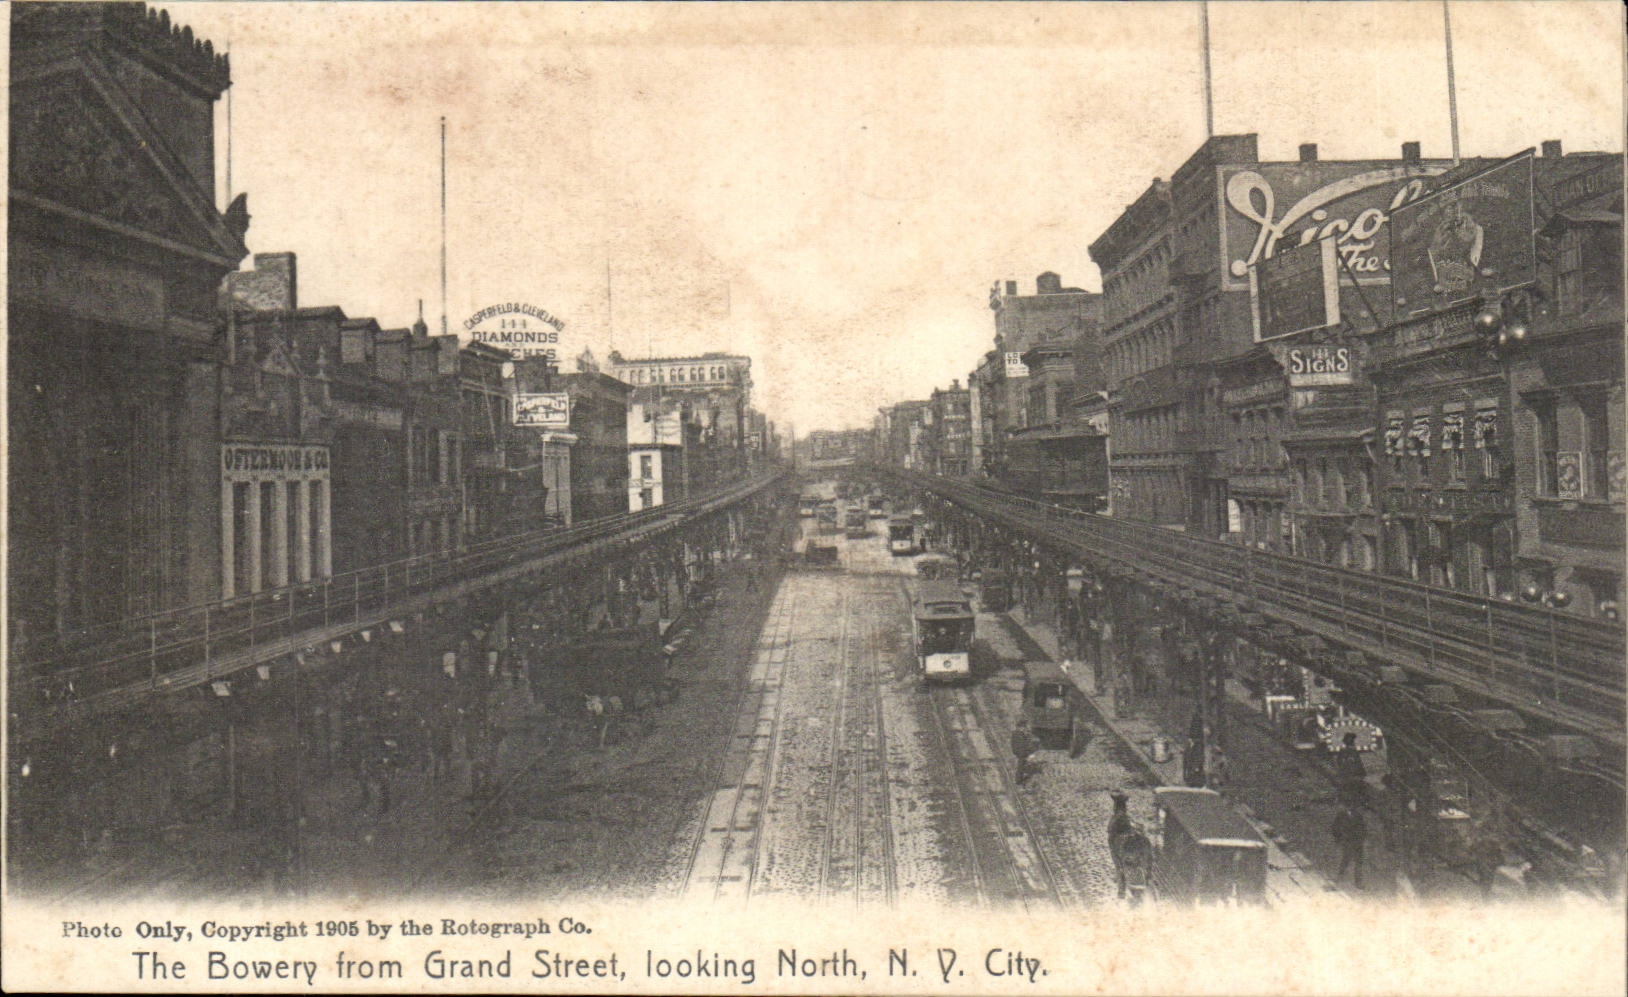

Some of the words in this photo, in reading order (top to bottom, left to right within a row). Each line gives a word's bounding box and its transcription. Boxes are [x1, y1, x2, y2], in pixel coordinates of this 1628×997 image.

[463, 303, 512, 330] CASPERFELD
[514, 303, 521, 313] &
[522, 303, 566, 332] CLEVELAND
[472, 331, 559, 343] DIAMONDS
[1291, 348, 1348, 373] SIGNS
